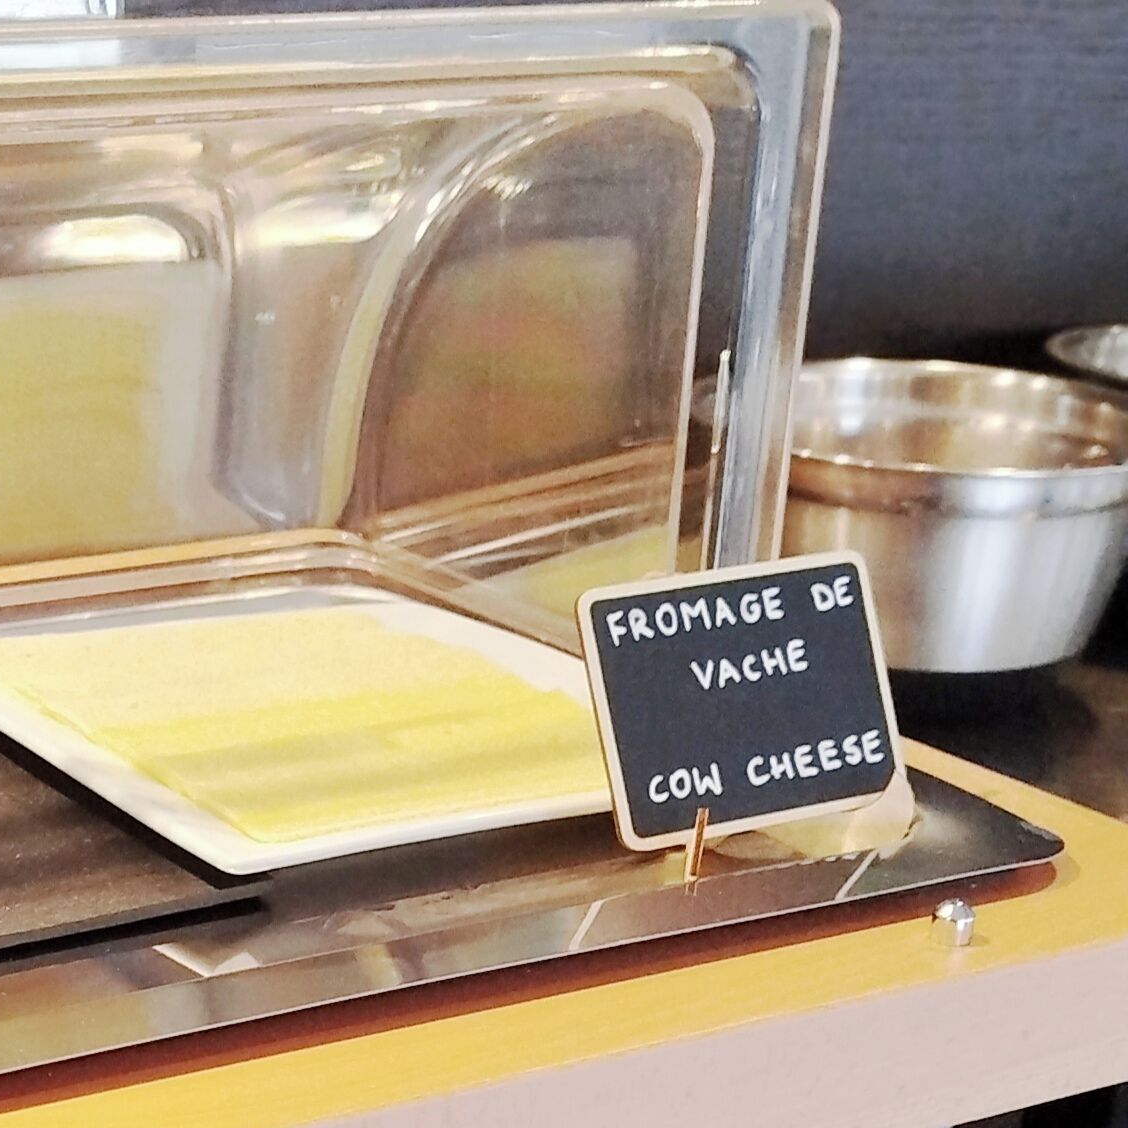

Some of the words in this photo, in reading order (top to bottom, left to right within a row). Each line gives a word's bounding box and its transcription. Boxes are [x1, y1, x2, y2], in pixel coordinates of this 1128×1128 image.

[606, 587, 785, 647] FROMAGE
[810, 575, 855, 612] DE
[690, 638, 809, 690] VACHE
[648, 762, 723, 803] COW
[746, 729, 885, 787] CHEESE
